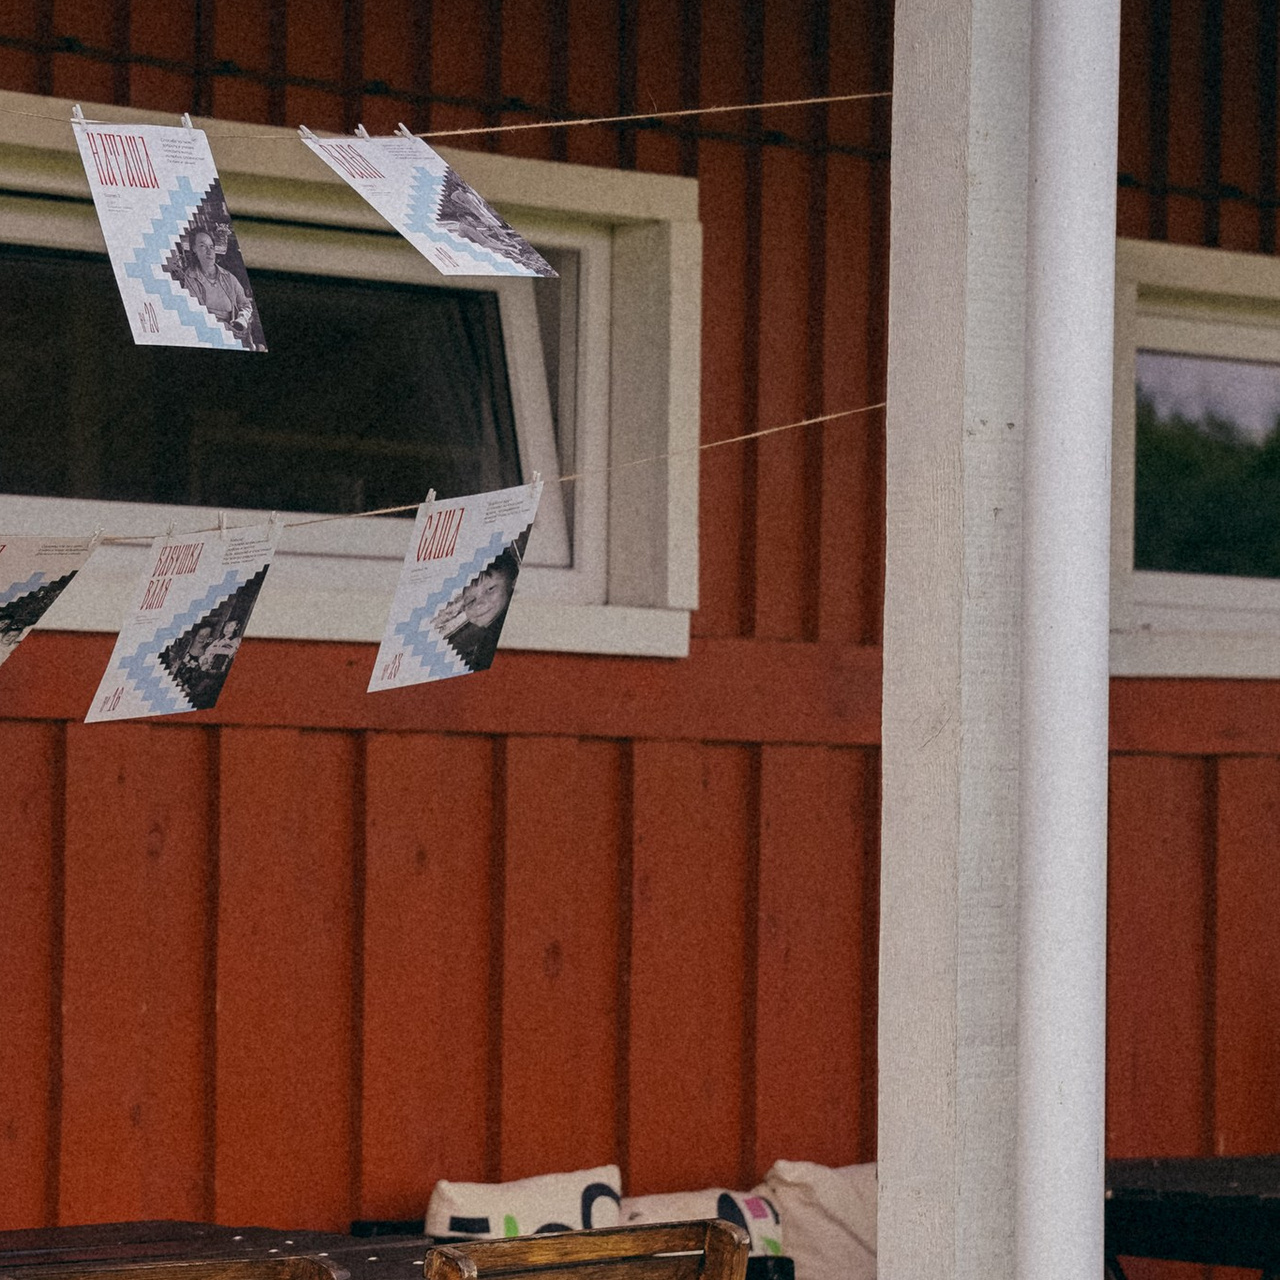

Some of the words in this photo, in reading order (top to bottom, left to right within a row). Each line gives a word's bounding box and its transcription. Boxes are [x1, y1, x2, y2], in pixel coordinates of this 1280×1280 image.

[86, 132, 159, 189] НАТАША
[319, 144, 385, 179] ВАНЯ
[417, 507, 464, 562] САША
[152, 543, 204, 577] БАБУШКА
[140, 578, 172, 610] ВАЛЯ
